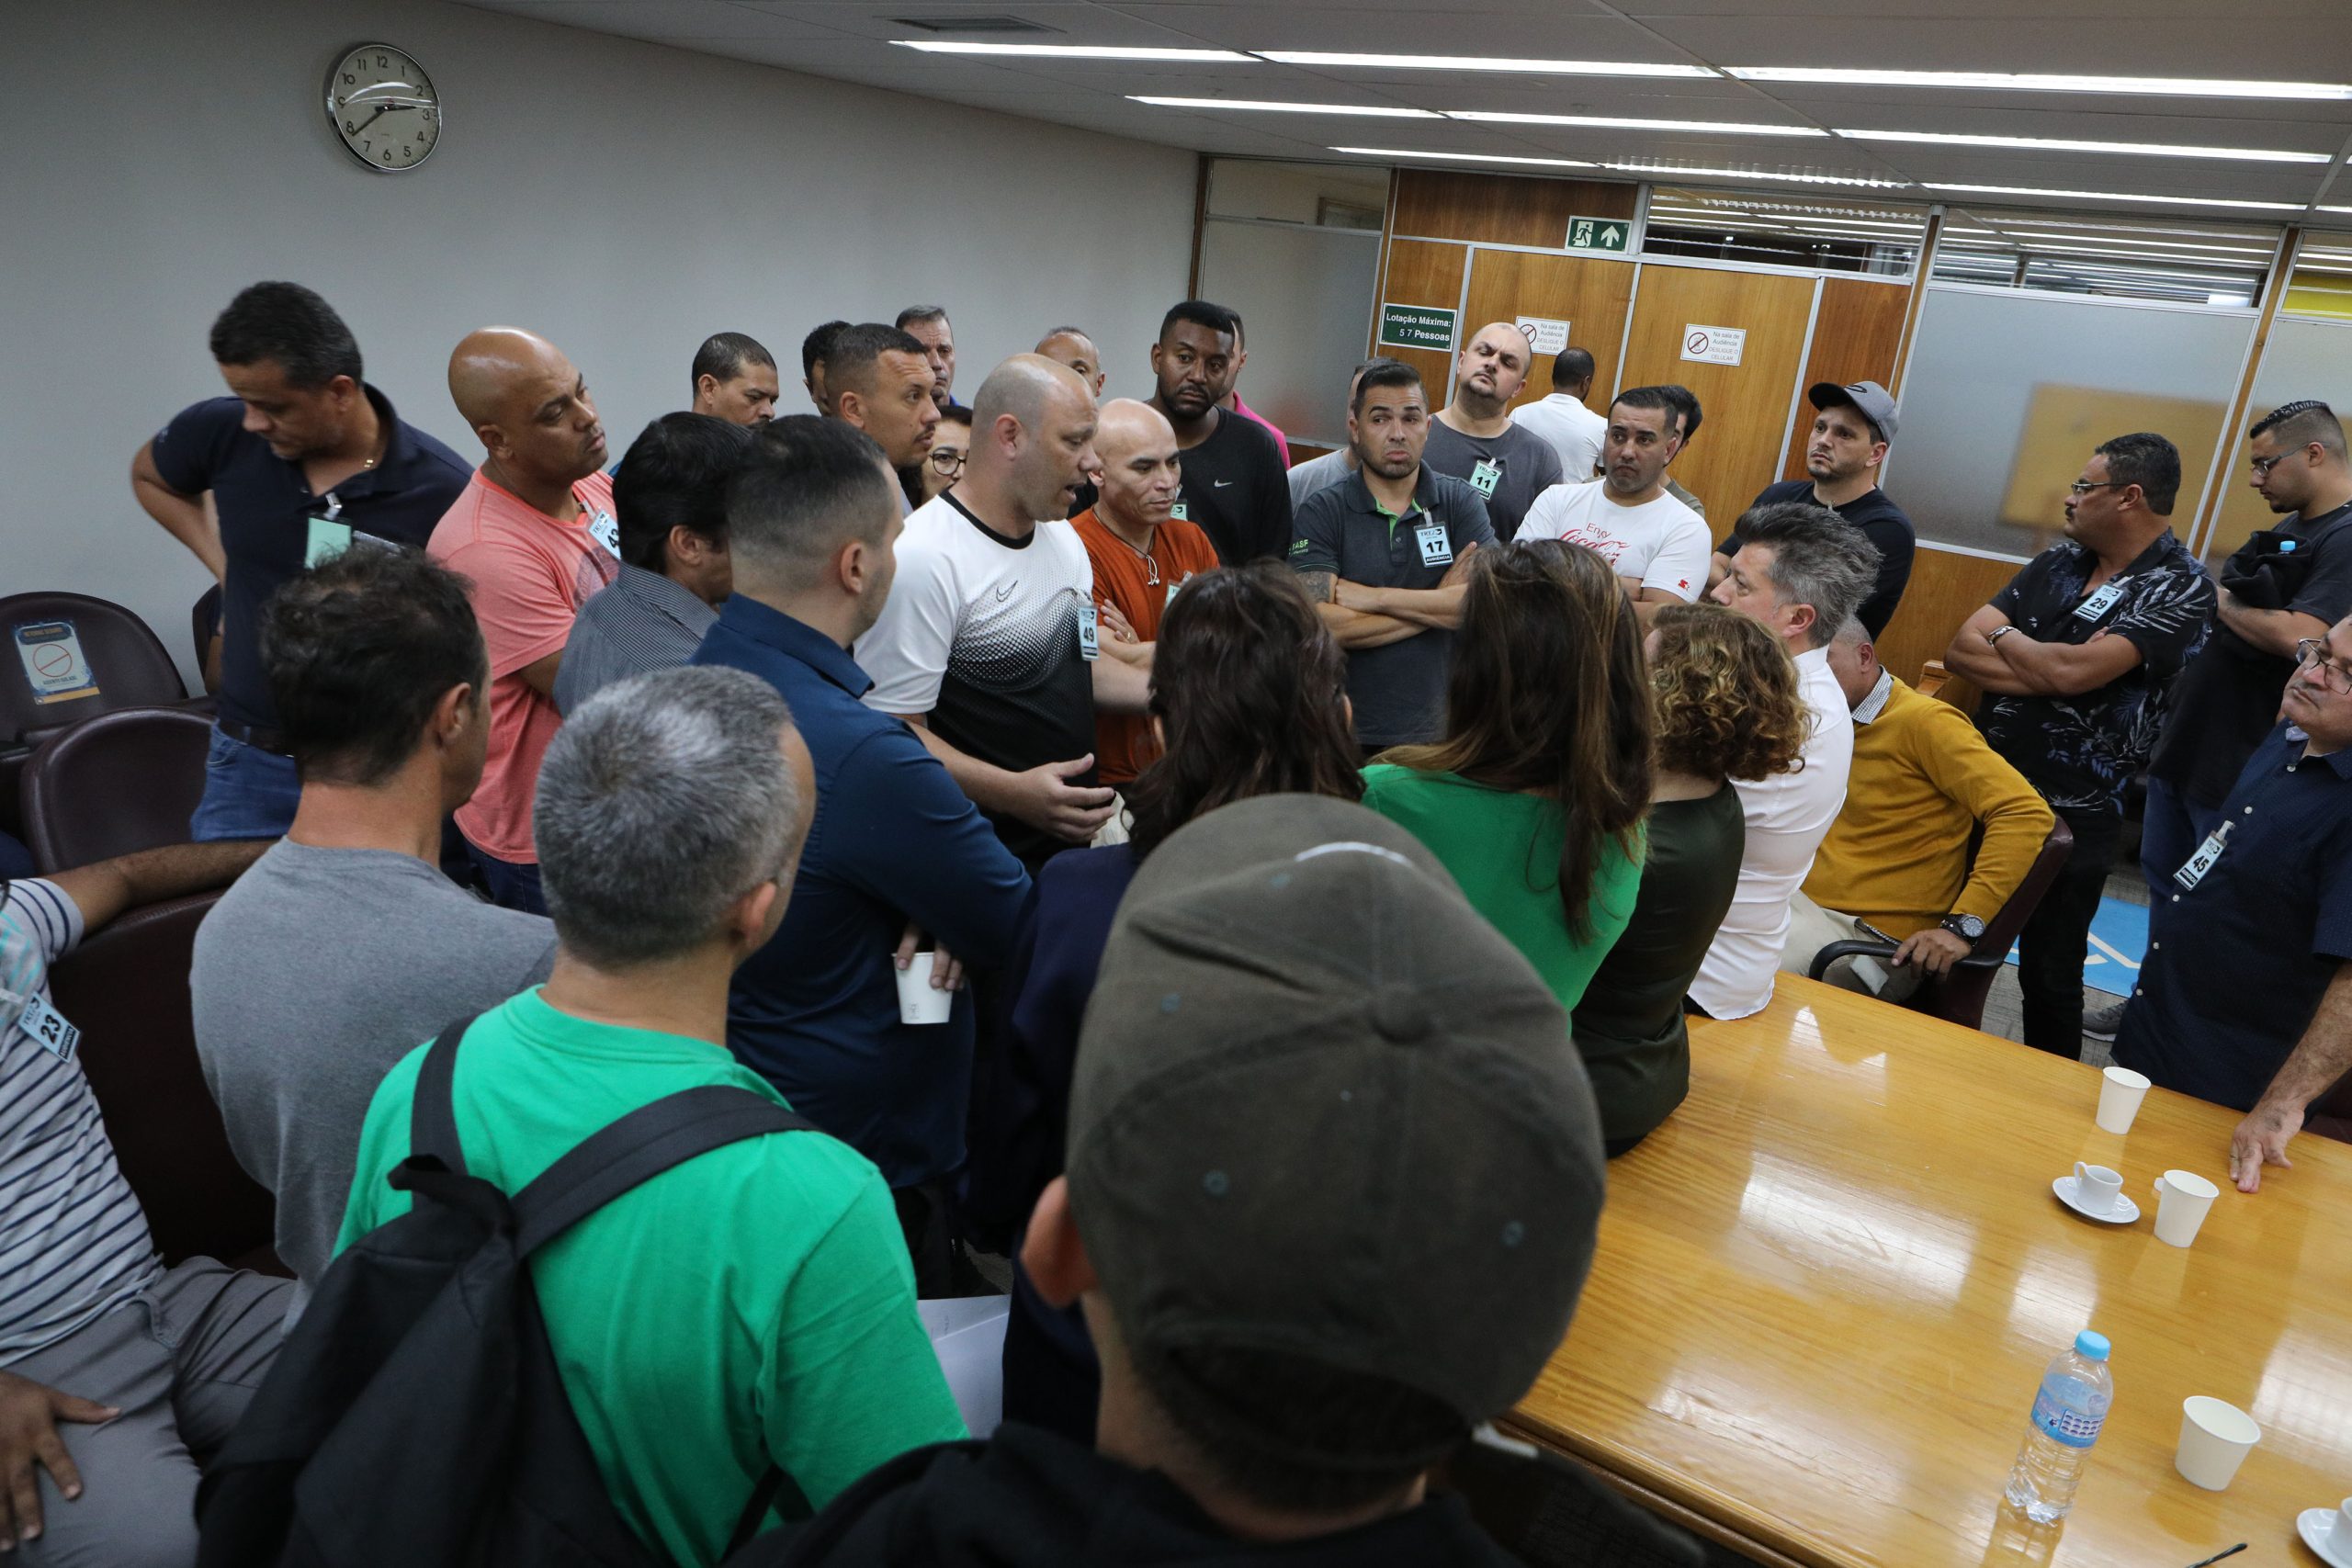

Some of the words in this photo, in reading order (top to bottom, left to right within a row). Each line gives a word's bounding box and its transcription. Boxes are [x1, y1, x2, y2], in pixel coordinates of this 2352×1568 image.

[357, 59, 367, 71] 11
[377, 55, 389, 69] 12
[401, 65, 405, 77] 1
[342, 73, 356, 85] 10
[415, 85, 424, 96] 2
[422, 109, 430, 121] 3
[346, 120, 355, 134] 8
[416, 131, 425, 142] 4
[363, 141, 371, 152] 7
[403, 146, 412, 158] 5
[383, 148, 391, 162] 6
[1386, 313, 1418, 325] Lotação
[1419, 316, 1452, 327] Máxima:
[1415, 330, 1450, 342] Pessoas
[1476, 476, 1491, 489] 11
[1426, 540, 1443, 553] 17
[2089, 597, 2109, 610] 29
[1083, 626, 1094, 643] 49
[2193, 855, 2210, 873] 45
[40, 1014, 61, 1043] 23
